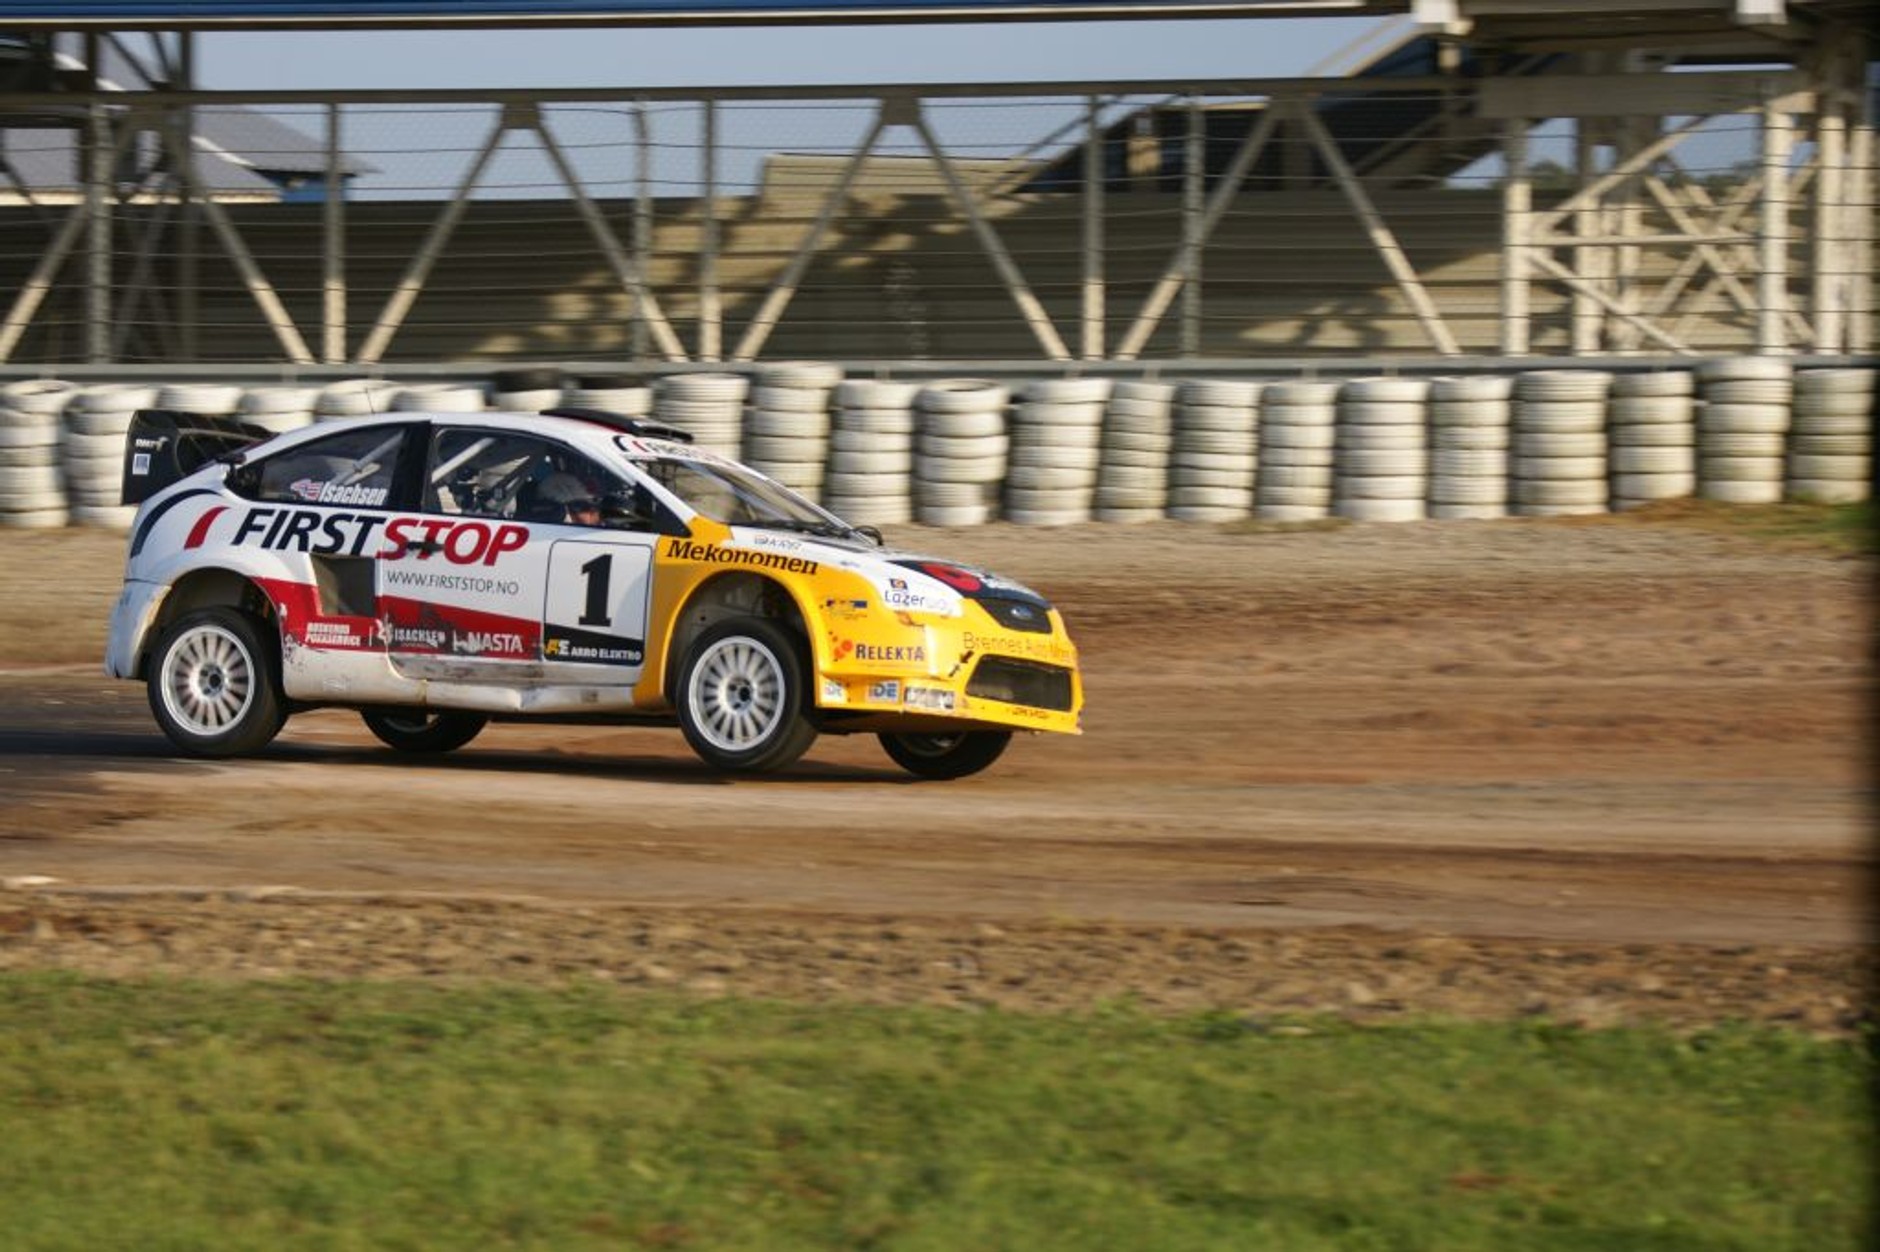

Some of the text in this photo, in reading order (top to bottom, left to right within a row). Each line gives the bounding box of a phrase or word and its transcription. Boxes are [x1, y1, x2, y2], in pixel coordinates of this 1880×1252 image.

[318, 481, 387, 506] Isachsen
[666, 539, 819, 576] Mekonomen
[386, 570, 519, 596] WWW.FIRSTSTOP.NO
[578, 553, 612, 627] 1
[394, 628, 446, 646] ISACHSEN
[467, 630, 524, 653] NASTA
[855, 643, 925, 662] RELEKTA
